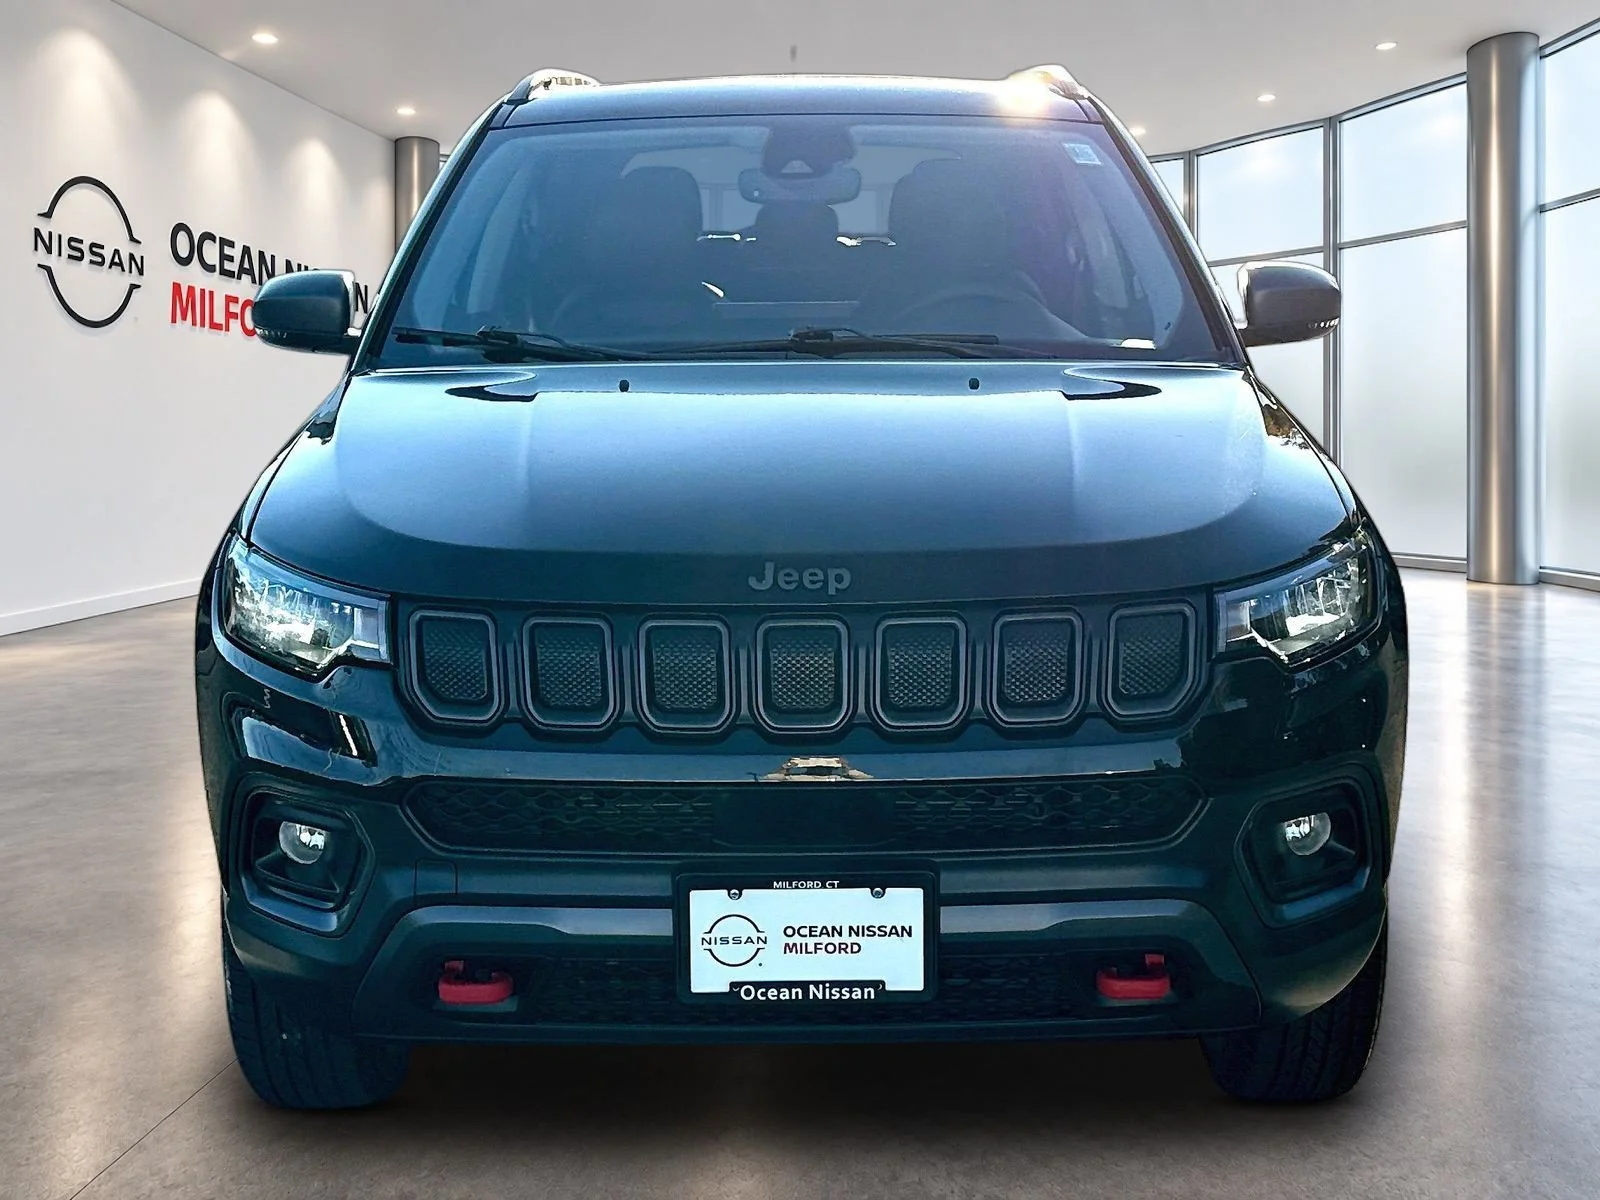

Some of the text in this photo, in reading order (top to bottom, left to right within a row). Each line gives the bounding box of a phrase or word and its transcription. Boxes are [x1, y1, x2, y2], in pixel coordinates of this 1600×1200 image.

[34, 228, 144, 276] NISSAN
[170, 222, 276, 286] OCEAN
[171, 282, 257, 337] MILFO
[748, 561, 852, 595] Jeep
[825, 880, 840, 889] CT
[783, 925, 913, 938] OCEAN NISSAN
[701, 936, 768, 946] NISSAN
[783, 942, 862, 955] MILFORD
[740, 984, 876, 1001] Ocean Nissan
